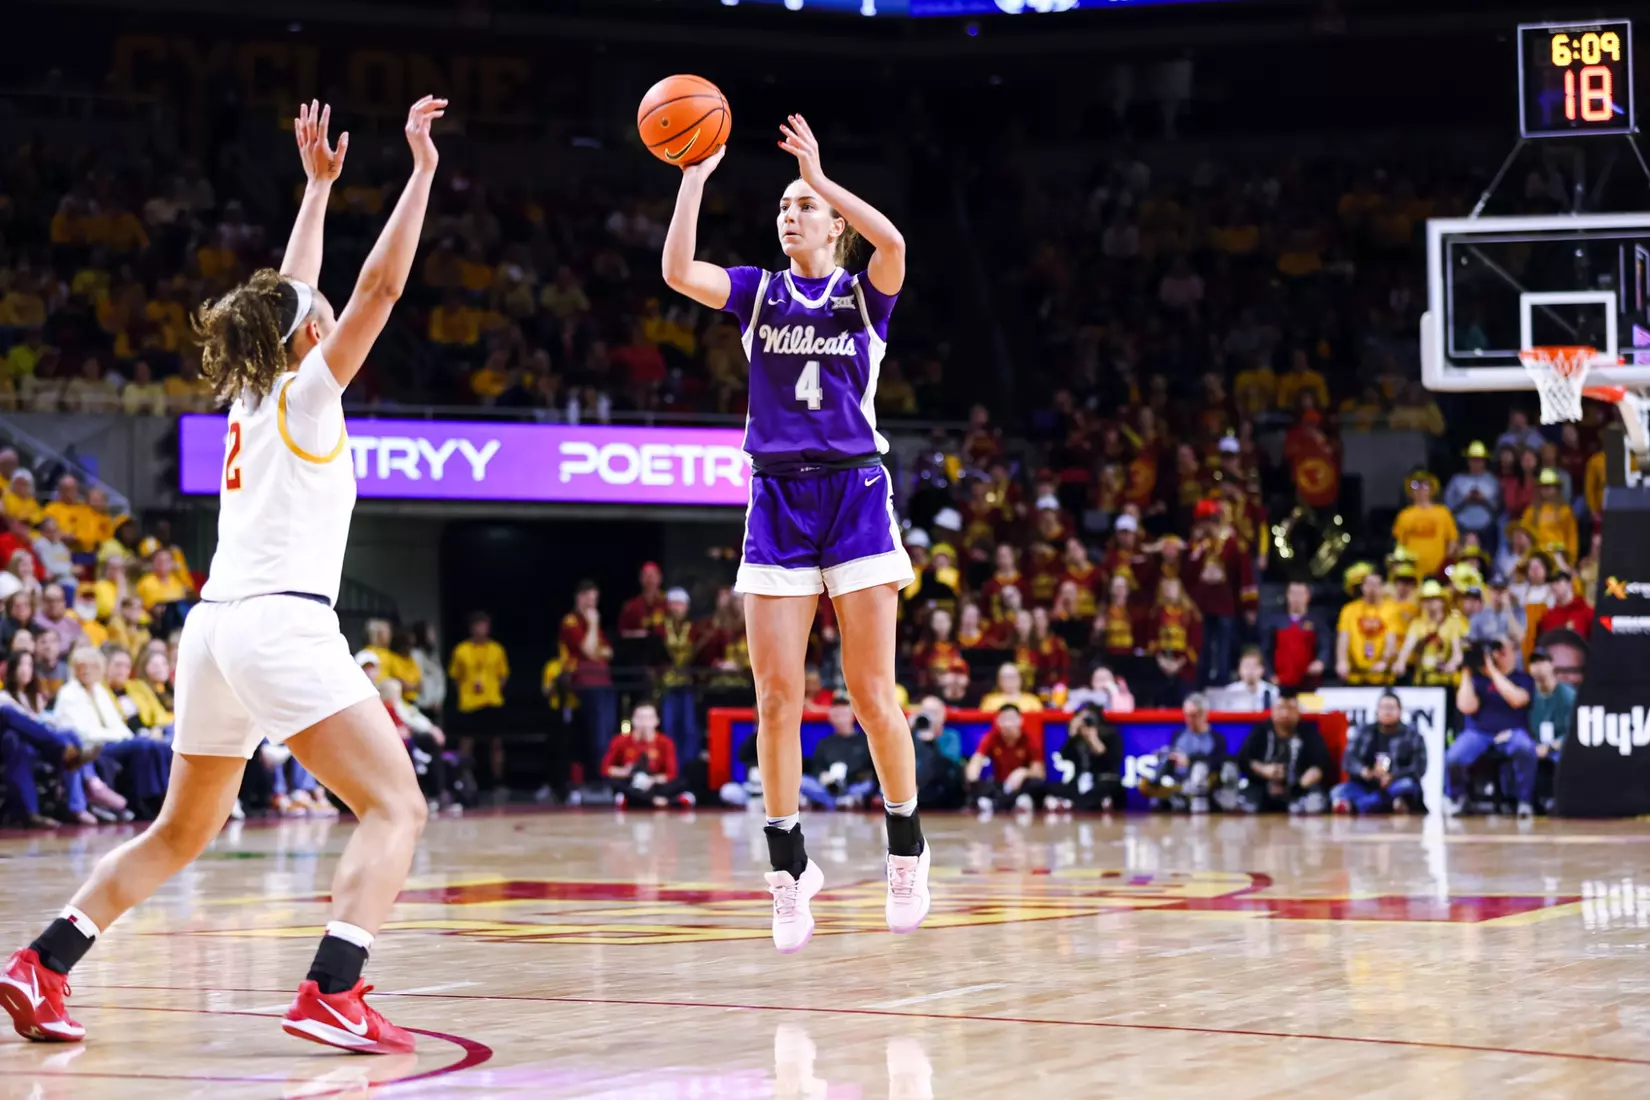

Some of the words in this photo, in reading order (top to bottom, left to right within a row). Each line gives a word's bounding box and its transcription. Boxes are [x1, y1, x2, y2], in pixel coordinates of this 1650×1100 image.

[1551, 31, 1621, 67] 6:09
[1564, 66, 1613, 122] 18
[759, 323, 857, 356] Wildcats
[795, 360, 823, 411] 4
[225, 419, 242, 493] 2
[349, 435, 501, 482] TRYY
